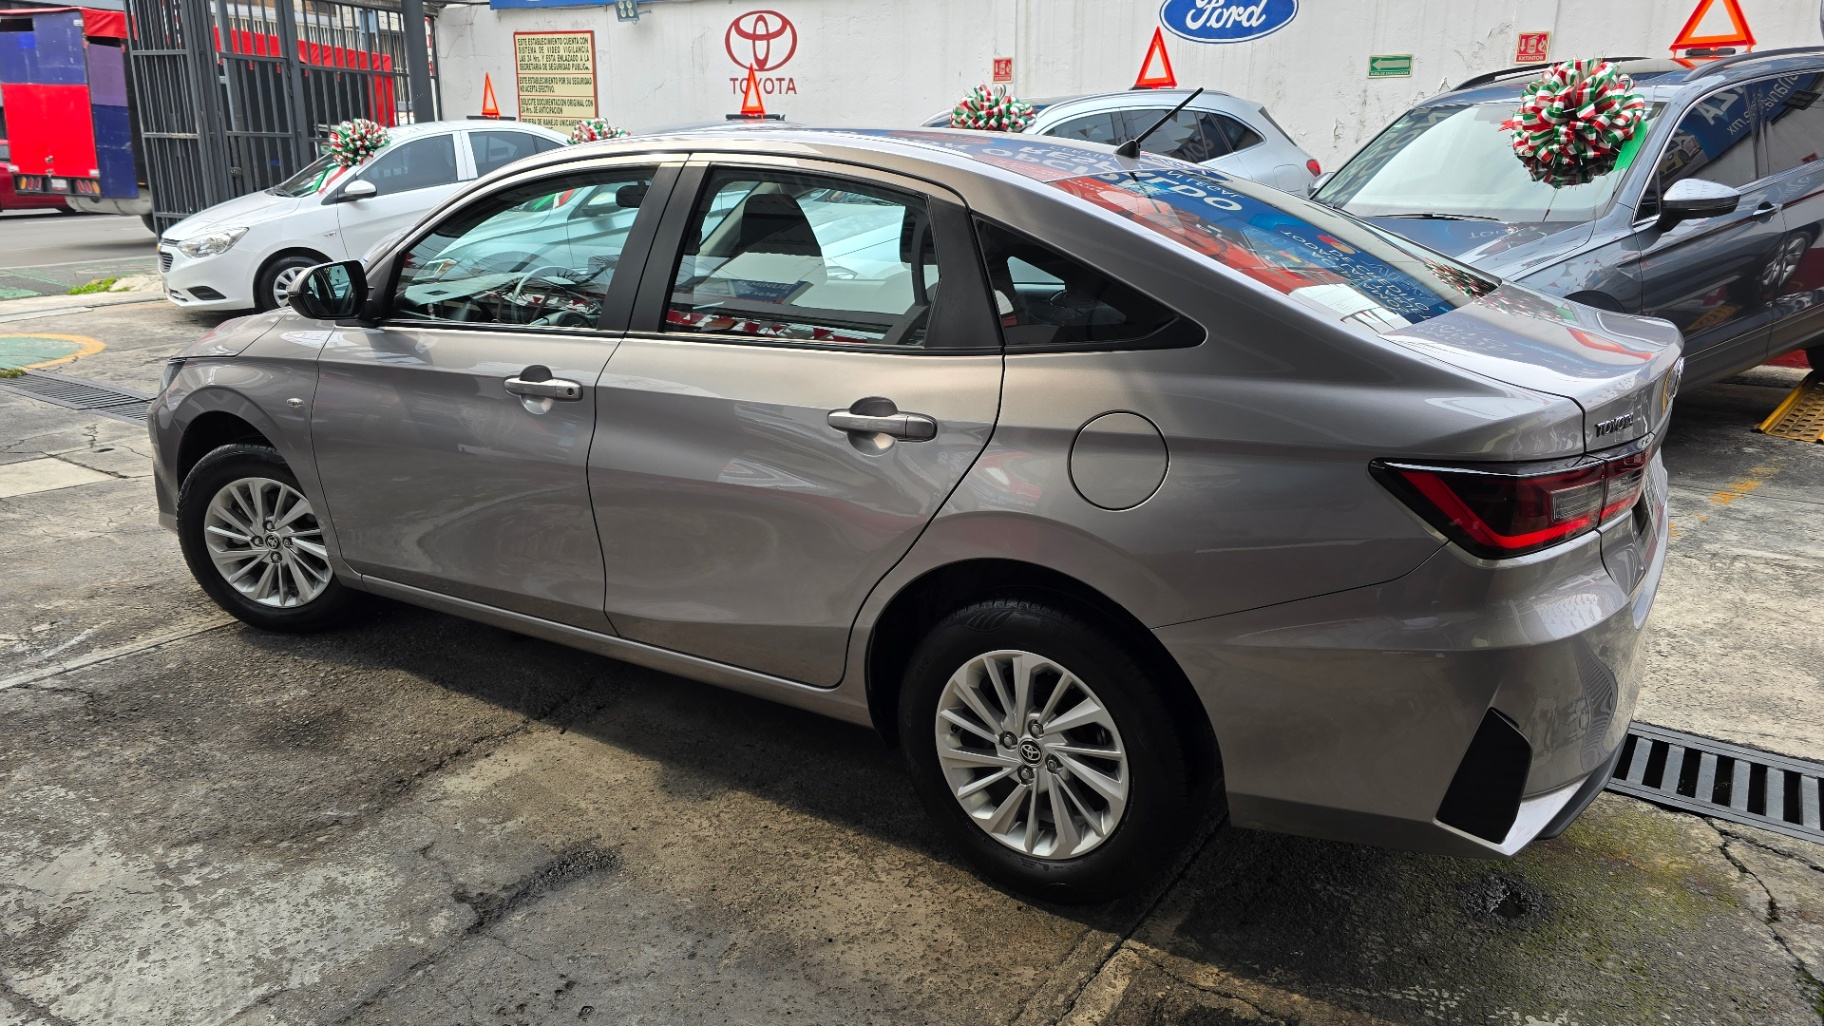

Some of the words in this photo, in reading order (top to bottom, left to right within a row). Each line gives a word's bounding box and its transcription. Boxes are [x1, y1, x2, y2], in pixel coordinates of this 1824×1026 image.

[1186, 0, 1266, 30] Ford
[518, 38, 527, 46] ESTE
[528, 37, 562, 46] ESTABLECIMIENTO
[563, 37, 579, 45] CUENTA
[580, 37, 589, 45] CON
[518, 46, 536, 54] SISTEMA
[539, 46, 545, 54] DE
[547, 46, 560, 54] VIDEO
[563, 45, 589, 54] VIGILANCIA
[546, 54, 556, 62] ESTA
[557, 54, 578, 62] ENLAZADO
[584, 54, 590, 62] LA
[519, 63, 541, 71] SECRETARIA
[548, 63, 571, 71] SEGURIDAD
[519, 77, 528, 85] ESTE
[528, 77, 558, 85] ESTABLECIMIENTO
[572, 77, 592, 86] SEGURIDAD
[525, 85, 538, 93] ACEPTA
[521, 98, 537, 106] SOLICITE
[537, 98, 567, 107] DOCUMENTACION
[567, 98, 585, 107] ORIGINAL
[585, 99, 594, 108] CON
[539, 106, 563, 115] ANTICIPACION
[559, 119, 582, 127] UNICAMENT
